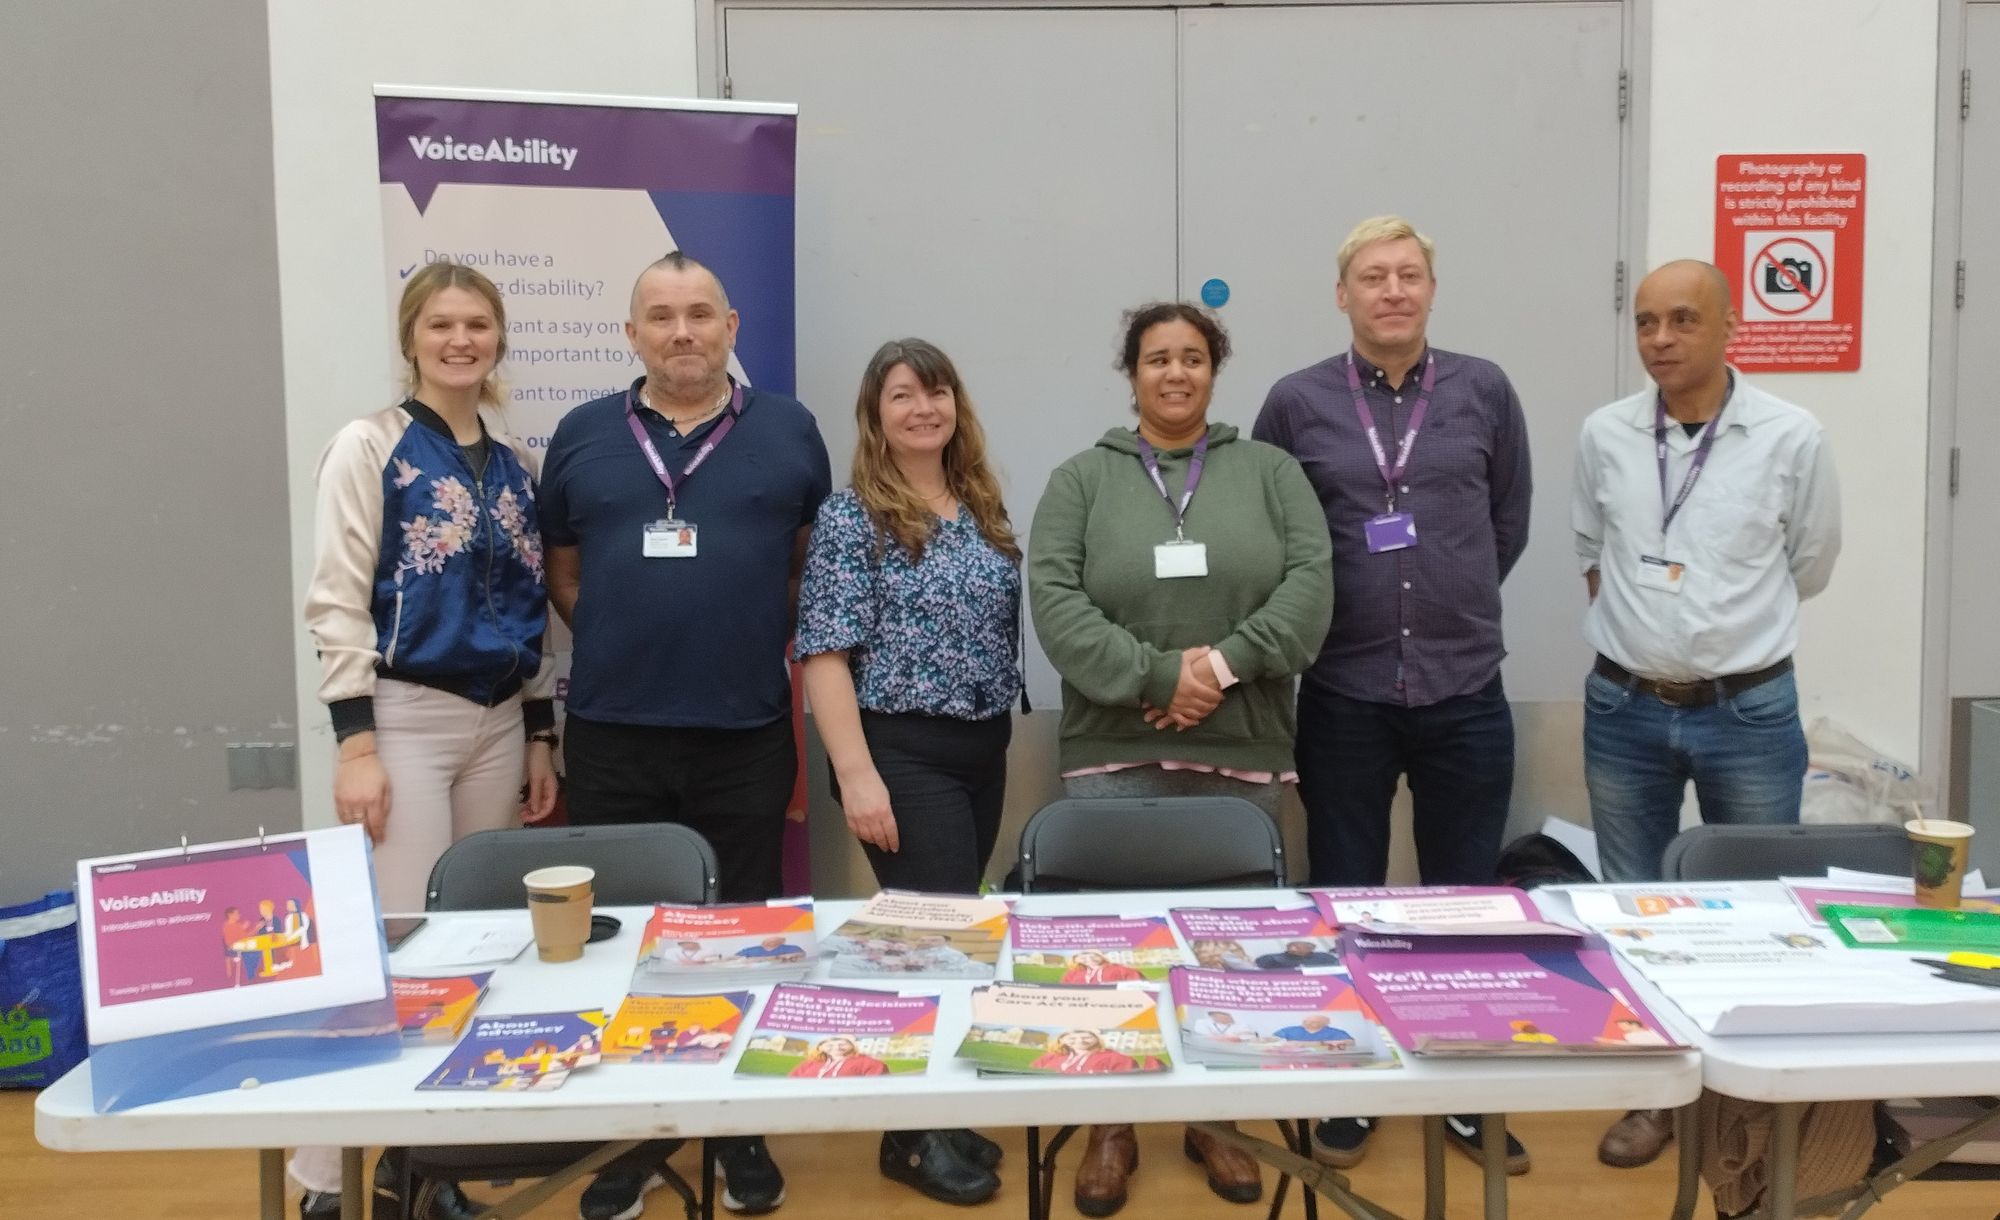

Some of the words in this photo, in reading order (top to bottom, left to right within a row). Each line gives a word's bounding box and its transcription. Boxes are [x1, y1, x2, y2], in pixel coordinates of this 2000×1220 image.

[408, 135, 578, 171] VoiceAbility
[1739, 161, 1826, 178] Photography
[1828, 163, 1844, 174] or
[1721, 179, 1785, 195] recording
[1787, 178, 1804, 191] of
[1805, 182, 1829, 195] any
[1831, 178, 1861, 191] kind
[1738, 196, 1784, 212] strictly
[1786, 195, 1857, 211] prohibited
[1804, 211, 1848, 228] facility
[424, 249, 450, 266] Do
[455, 252, 489, 266] you
[494, 249, 540, 267] have
[544, 255, 554, 267] a
[508, 279, 604, 301] disability?
[548, 322, 558, 334] a
[562, 321, 593, 338] say
[597, 322, 620, 334] on
[506, 348, 601, 365] important
[605, 348, 623, 362] to
[512, 386, 544, 401] ant
[549, 387, 566, 401] to
[99, 888, 208, 913] VoiceAbility
[1367, 970, 1428, 983] We'll
[1431, 969, 1494, 982] make
[1496, 971, 1549, 980] sure
[1375, 981, 1449, 994] you're
[1450, 979, 1528, 990] heard.
[777, 992, 814, 1004] Help
[818, 995, 853, 1006] with
[855, 1000, 925, 1009] decisions
[998, 991, 1048, 1000] About
[774, 1000, 822, 1010] about
[825, 1005, 862, 1014] your
[476, 1025, 565, 1038] advocacy
[478, 1020, 538, 1030] About
[828, 1018, 892, 1028] support
